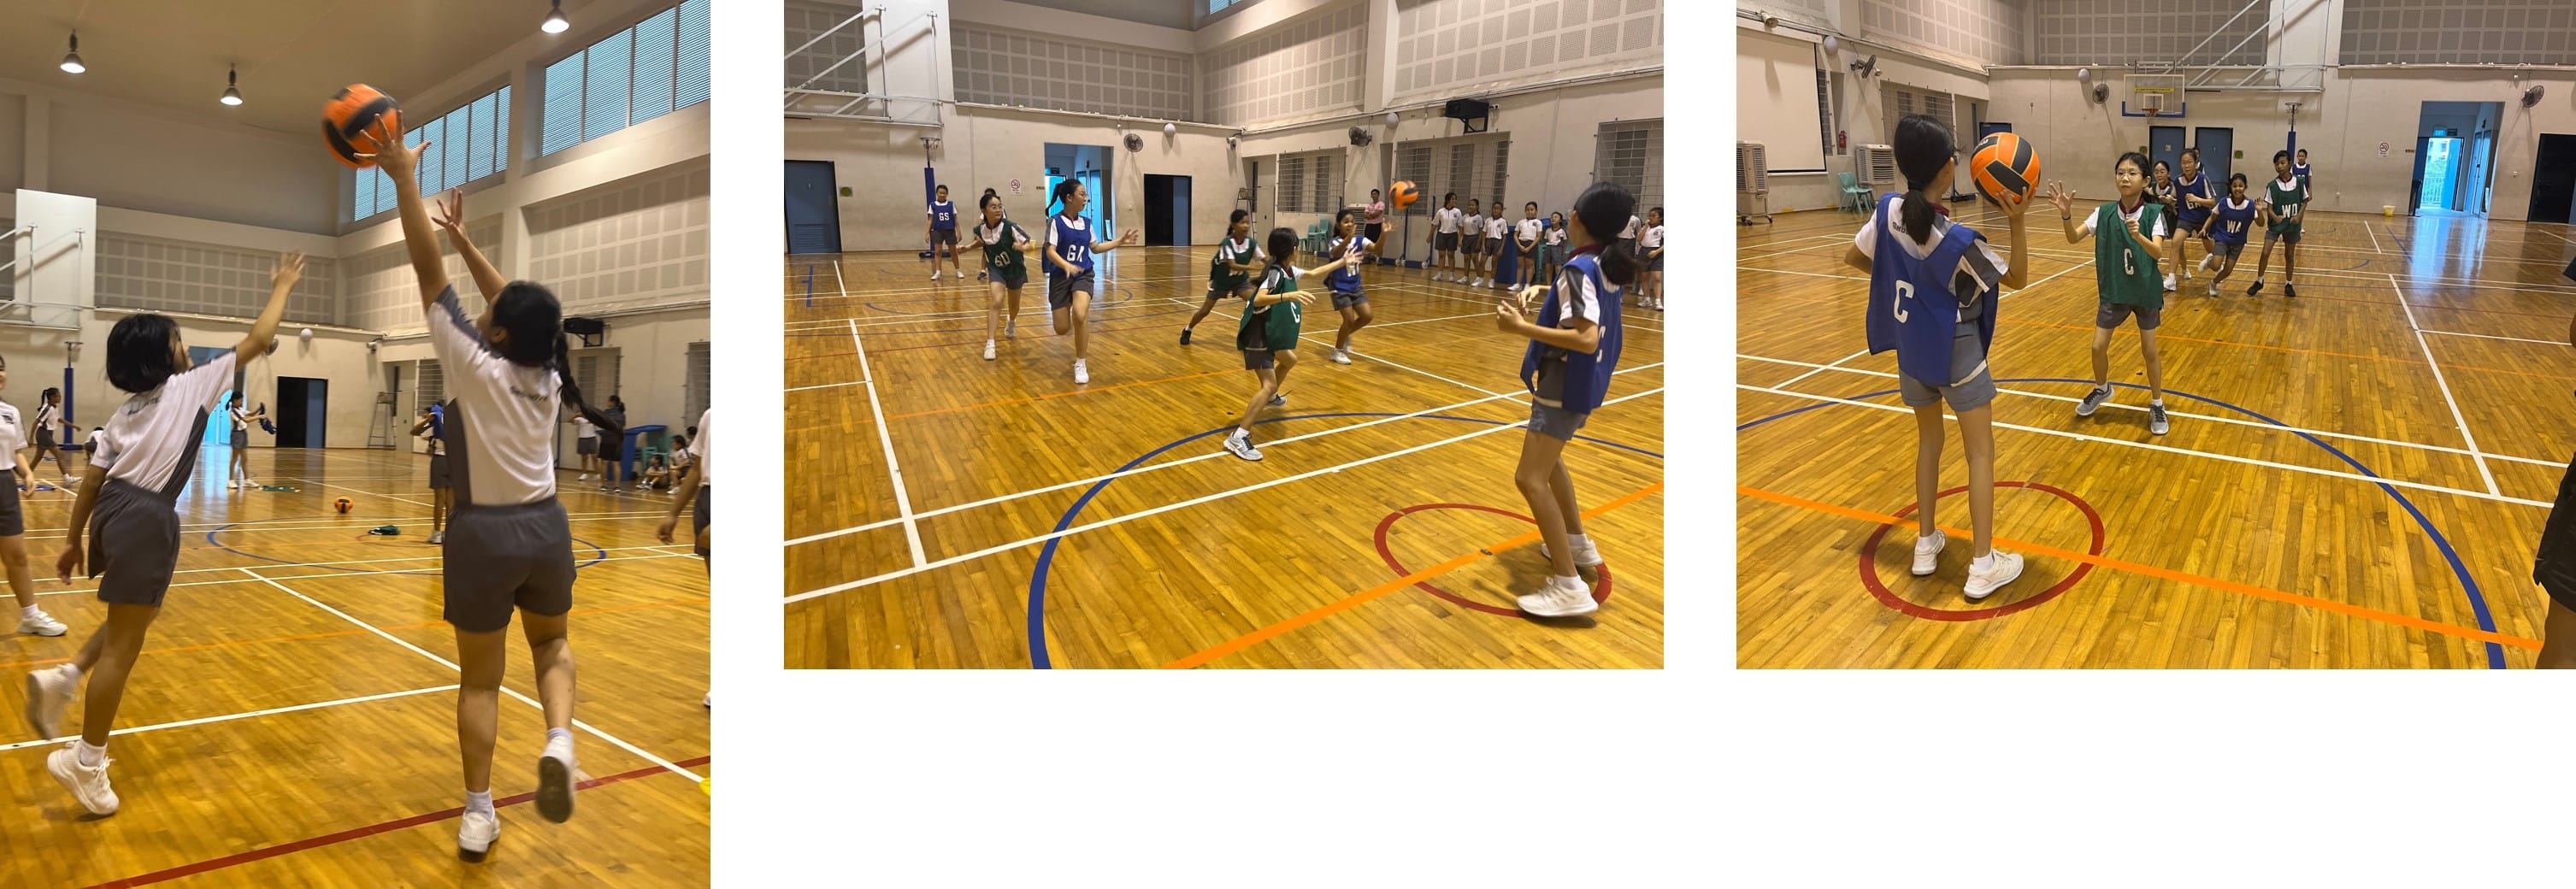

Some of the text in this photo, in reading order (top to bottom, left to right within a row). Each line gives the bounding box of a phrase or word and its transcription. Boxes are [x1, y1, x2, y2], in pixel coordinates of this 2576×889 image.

[939, 212, 950, 221] GS
[2282, 203, 2298, 219] WD
[1892, 221, 1909, 235] SHU
[2226, 220, 2242, 233] WA
[994, 251, 1011, 267] GD
[1066, 244, 1085, 262] GA
[2124, 248, 2135, 275] C
[1894, 280, 1915, 323] C
[1290, 301, 1300, 323] C
